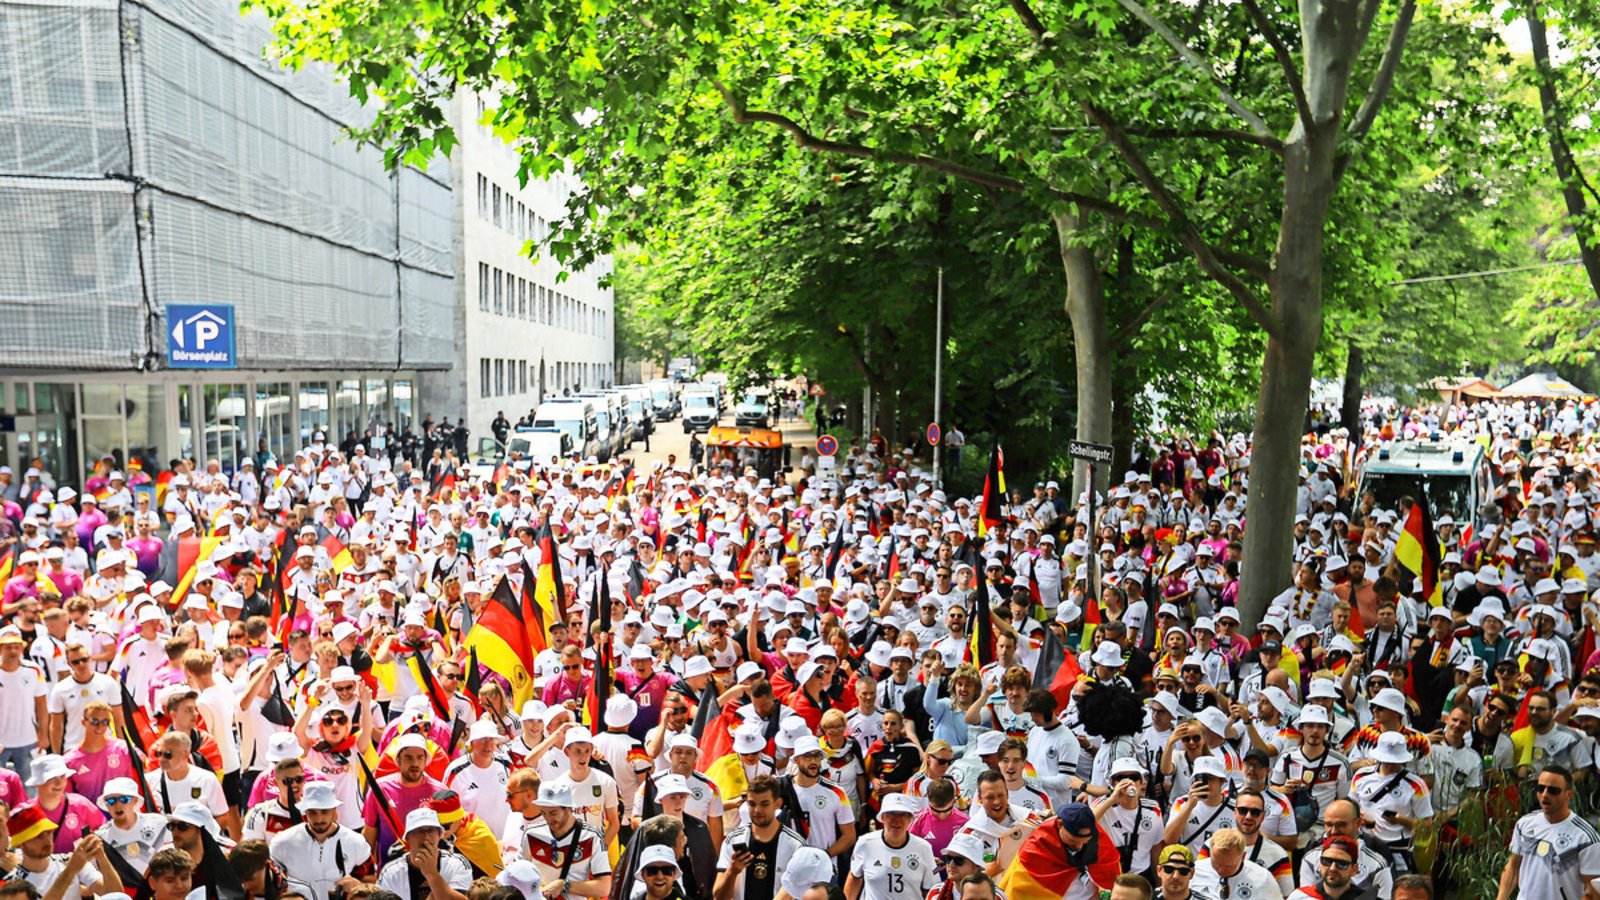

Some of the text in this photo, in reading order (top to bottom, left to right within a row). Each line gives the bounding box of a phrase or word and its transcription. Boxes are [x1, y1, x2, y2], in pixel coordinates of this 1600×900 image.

[195, 320, 220, 350] P
[172, 350, 229, 363] Börsenplatz
[1070, 443, 1112, 461] Schellingstr.
[835, 770, 842, 784] 7
[888, 873, 904, 894] 13
